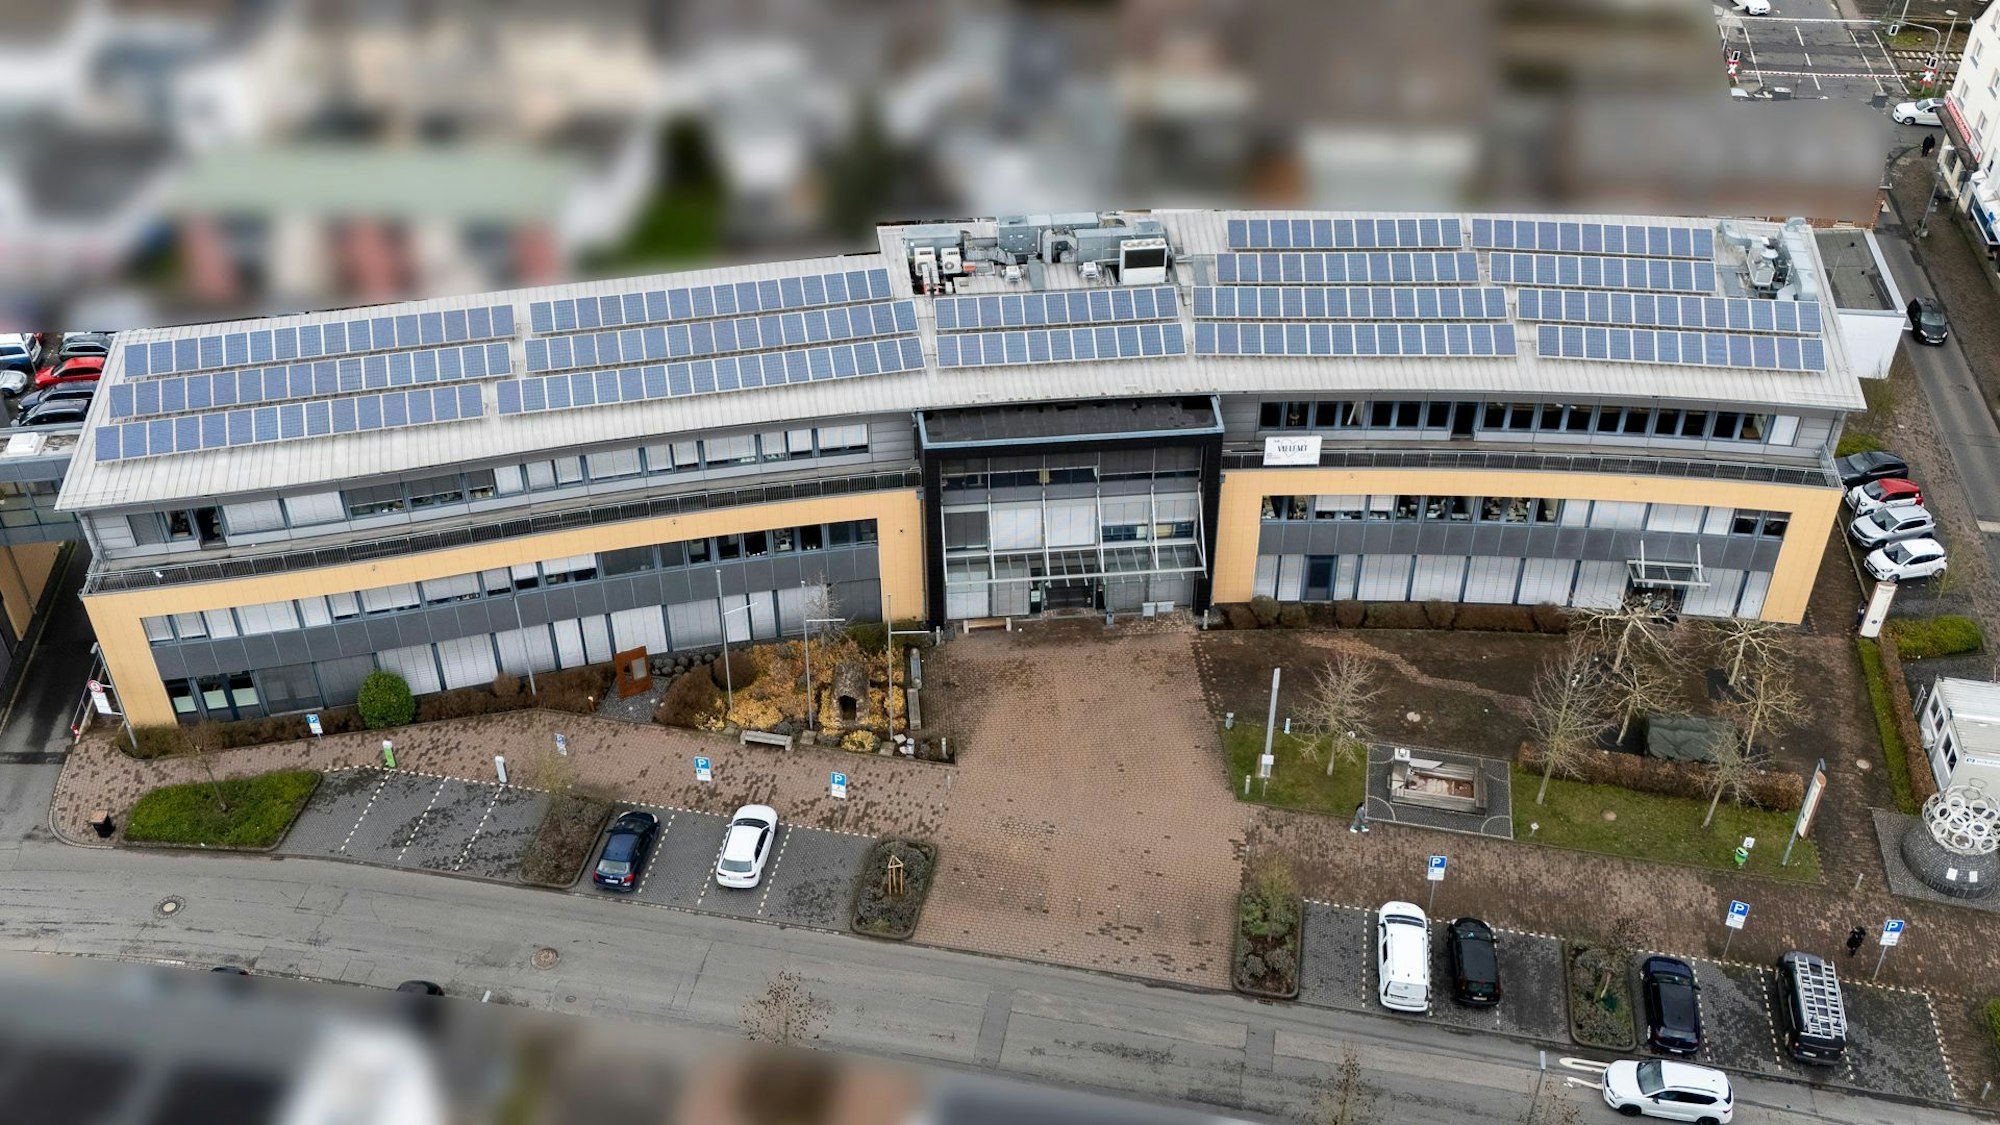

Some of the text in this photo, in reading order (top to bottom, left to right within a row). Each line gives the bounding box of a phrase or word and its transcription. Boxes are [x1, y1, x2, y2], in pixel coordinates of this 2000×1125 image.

[698, 759, 706, 768] P
[835, 775, 843, 784] P
[1432, 858, 1441, 867] P
[1734, 904, 1744, 913] P
[1887, 922, 1898, 931] P
